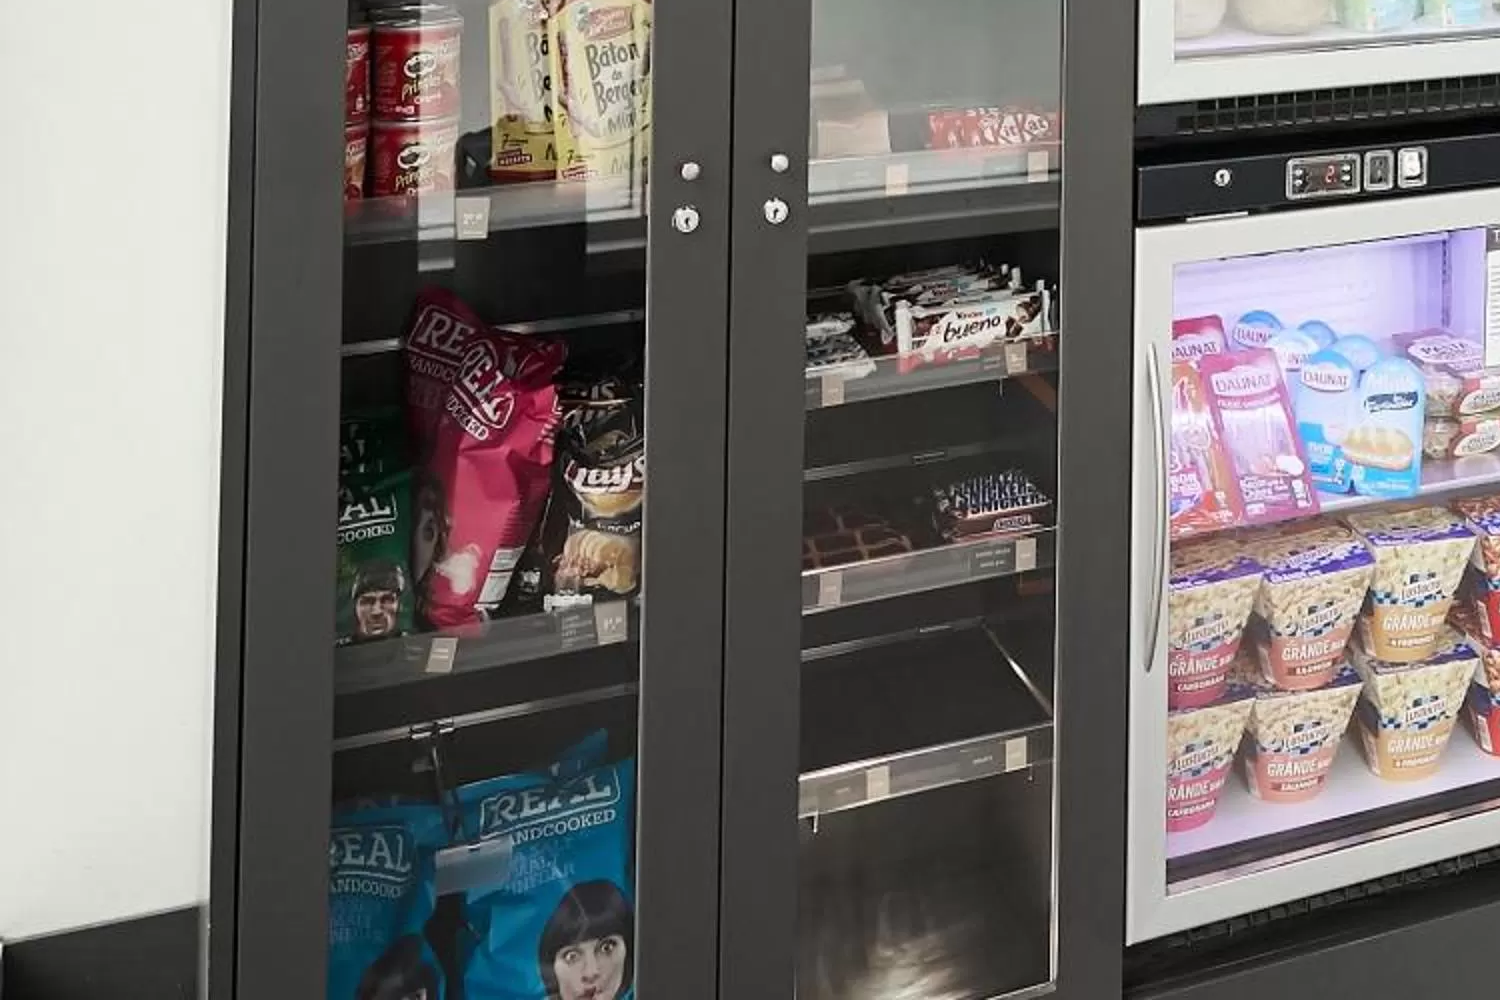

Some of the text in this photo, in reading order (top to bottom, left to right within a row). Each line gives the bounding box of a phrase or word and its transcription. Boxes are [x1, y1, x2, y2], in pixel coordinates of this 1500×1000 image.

[585, 42, 640, 81] Bâton
[943, 315, 1001, 342] bueno
[1214, 372, 1272, 394] DAUNAT
[1301, 371, 1349, 386] DAUNAT
[1282, 643, 1330, 661] GRANDE
[1169, 657, 1218, 676] GRANDE
[1267, 759, 1317, 777] GRANDE
[1167, 779, 1210, 801] RANDE
